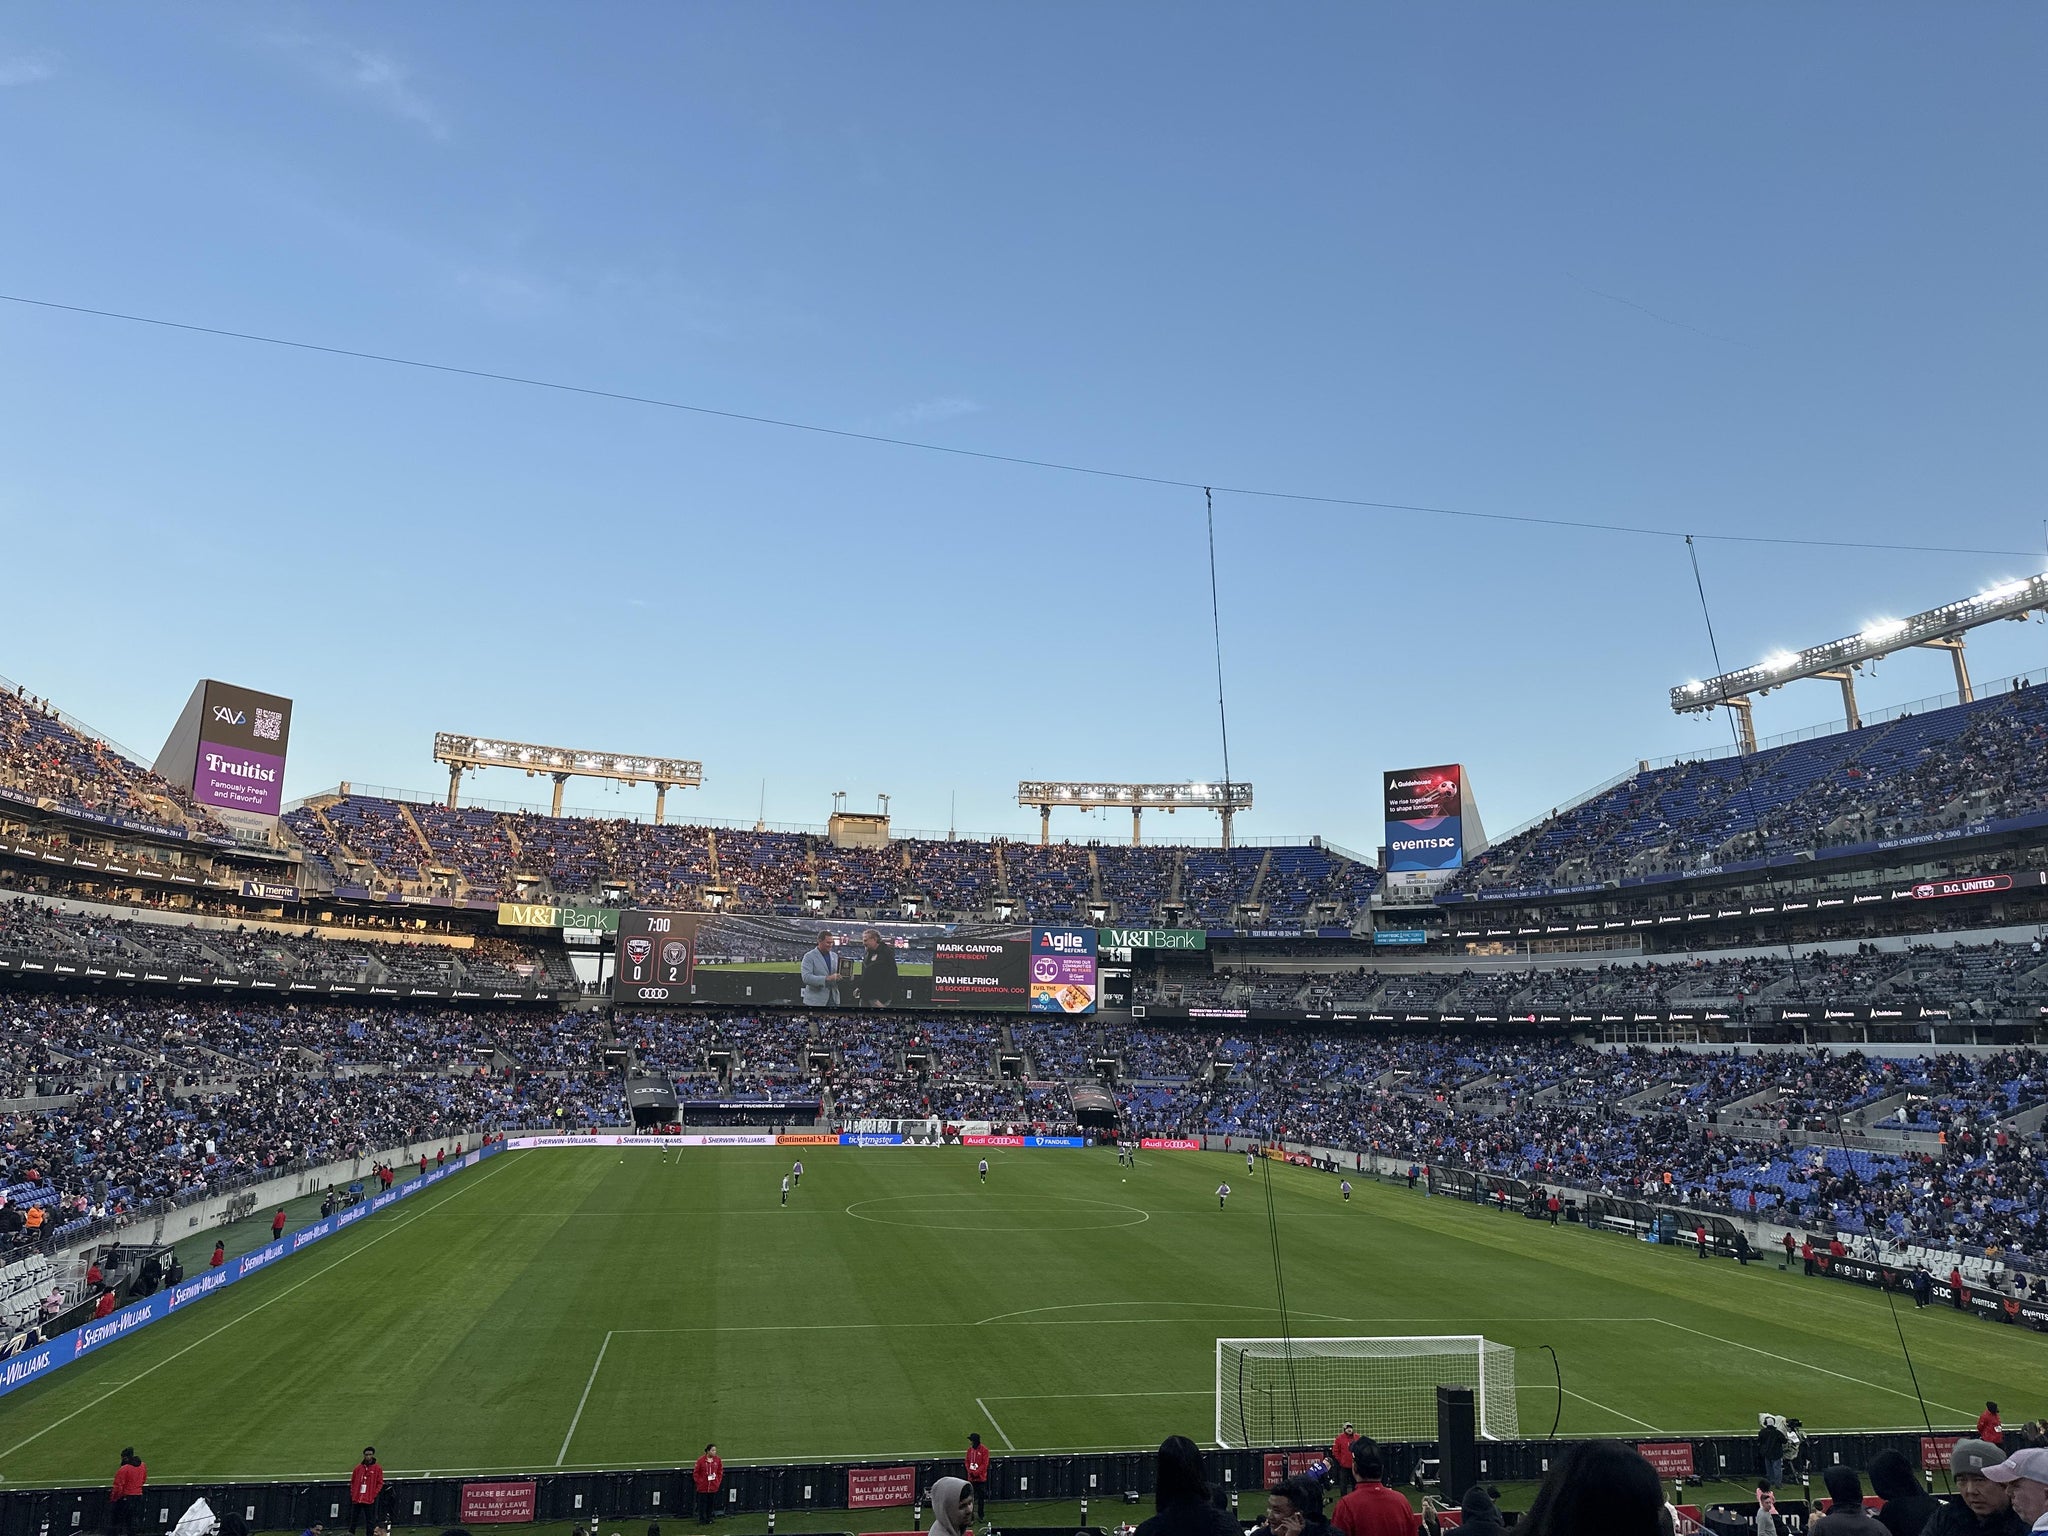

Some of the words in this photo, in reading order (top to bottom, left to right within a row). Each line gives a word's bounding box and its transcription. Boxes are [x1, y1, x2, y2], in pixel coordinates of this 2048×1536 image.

[205, 753, 277, 783] Fruitist
[210, 779, 246, 792] Famously
[247, 786, 268, 796] Fresh
[213, 790, 228, 799] and
[230, 792, 263, 805] Flavorful
[1396, 805, 1412, 813] shape
[1439, 837, 1455, 847] DC
[1878, 840, 1899, 850] WORLD
[1899, 834, 1934, 847] CHAMPIONS
[1945, 829, 1961, 838] 2000
[1974, 824, 1991, 834] 2012
[1682, 869, 1697, 878] RING
[1700, 866, 1723, 876] HONOR
[266, 887, 293, 897] merritt
[1943, 883, 1961, 894] D.C.
[1962, 879, 1995, 891] UNITED
[510, 905, 562, 926] M&T
[562, 908, 608, 929] Bank
[647, 917, 670, 933] 7:00
[1040, 931, 1083, 951] Agile
[1110, 930, 1154, 947] M&T
[1154, 931, 1196, 948] Bank
[936, 943, 964, 952] MARK
[965, 944, 1003, 953] CANTOR
[633, 965, 641, 981] 0
[669, 966, 677, 982] 2
[1036, 963, 1057, 976] 90
[935, 976, 955, 984] DAN
[956, 976, 999, 986] HELFRICH
[777, 1135, 818, 1144] Continental
[822, 1135, 838, 1143] Tire
[1939, 1286, 1952, 1299] DC
[506, 1489, 531, 1497] ALERT!
